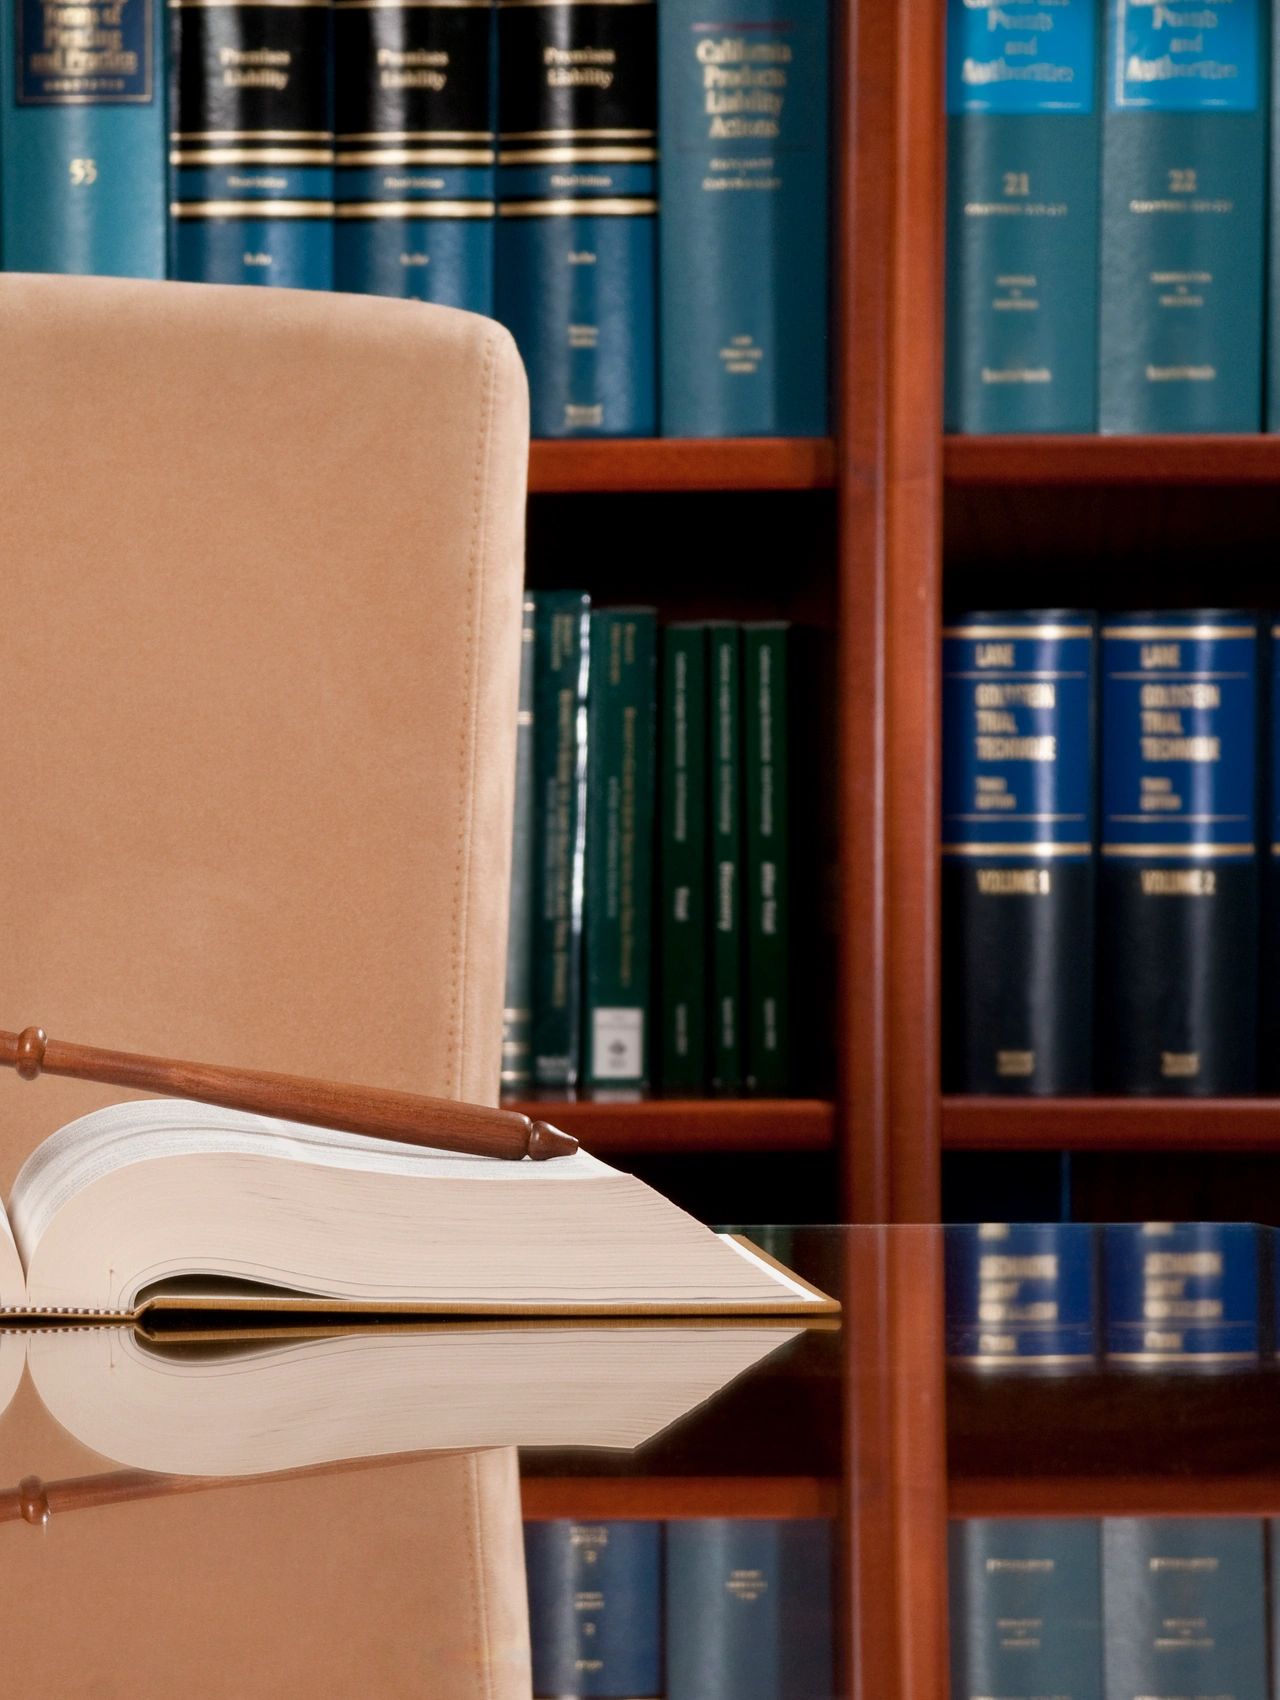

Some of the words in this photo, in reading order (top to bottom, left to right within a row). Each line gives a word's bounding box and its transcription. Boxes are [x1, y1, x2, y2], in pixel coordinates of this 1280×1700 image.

[221, 49, 290, 65] Premises
[377, 48, 449, 66] Premises
[544, 47, 615, 64] Premises
[696, 38, 792, 64] California
[223, 68, 288, 90] Liability
[380, 70, 447, 91] Liability
[547, 67, 613, 89] Liability
[703, 64, 787, 88] Products
[706, 90, 785, 117] Liability
[708, 117, 780, 138] Actions
[70, 158, 97, 186] 55
[1003, 172, 1030, 196] 21
[1168, 169, 1197, 193] 22
[977, 869, 1036, 895] VOLUME
[1141, 869, 1203, 895] VOLUME
